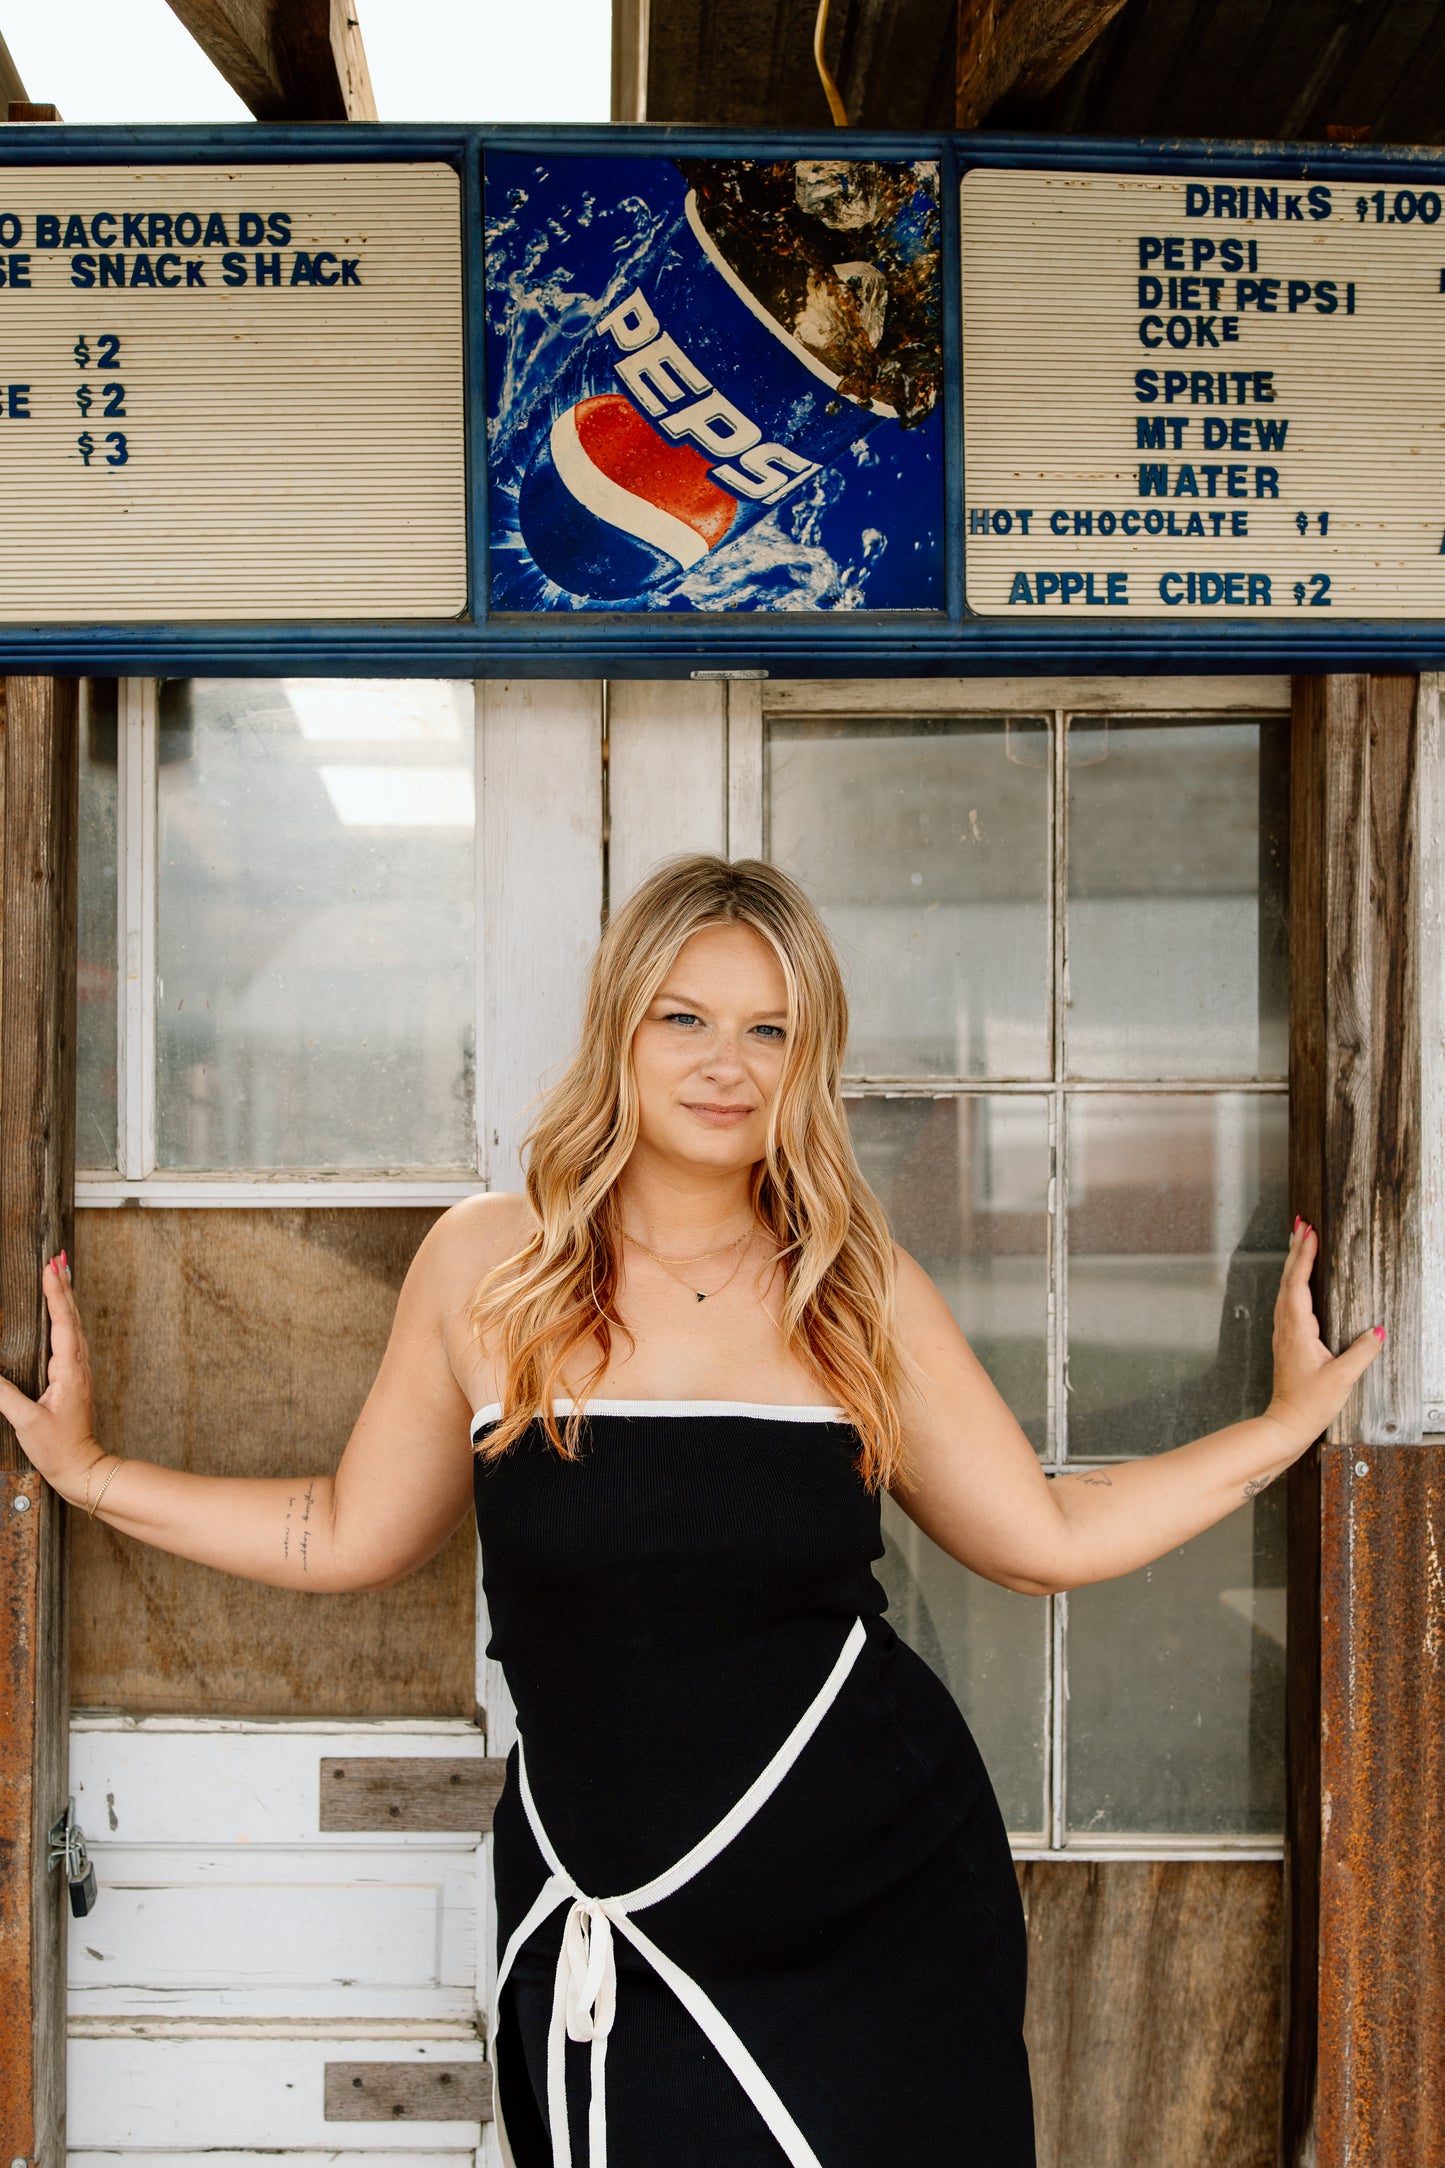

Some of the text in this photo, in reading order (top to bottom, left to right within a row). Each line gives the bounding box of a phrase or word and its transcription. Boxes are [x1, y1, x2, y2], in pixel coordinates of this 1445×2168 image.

[1186, 184, 1443, 225] DRINKS $1.00
[36, 212, 292, 249] BACKROADS
[71, 252, 207, 289] SNACK
[222, 251, 362, 288] SHACK
[1139, 236, 1259, 273] PEPSI
[1138, 275, 1356, 315] DIET PEPSI
[1139, 314, 1240, 350] COKE
[1135, 368, 1276, 405] SPRITE
[1137, 415, 1290, 452] MT DEW
[1139, 463, 1280, 498] WATER
[970, 508, 1330, 537] HOT CHOCOLATE $1
[1009, 571, 1333, 606] APPLE CIDER $2
